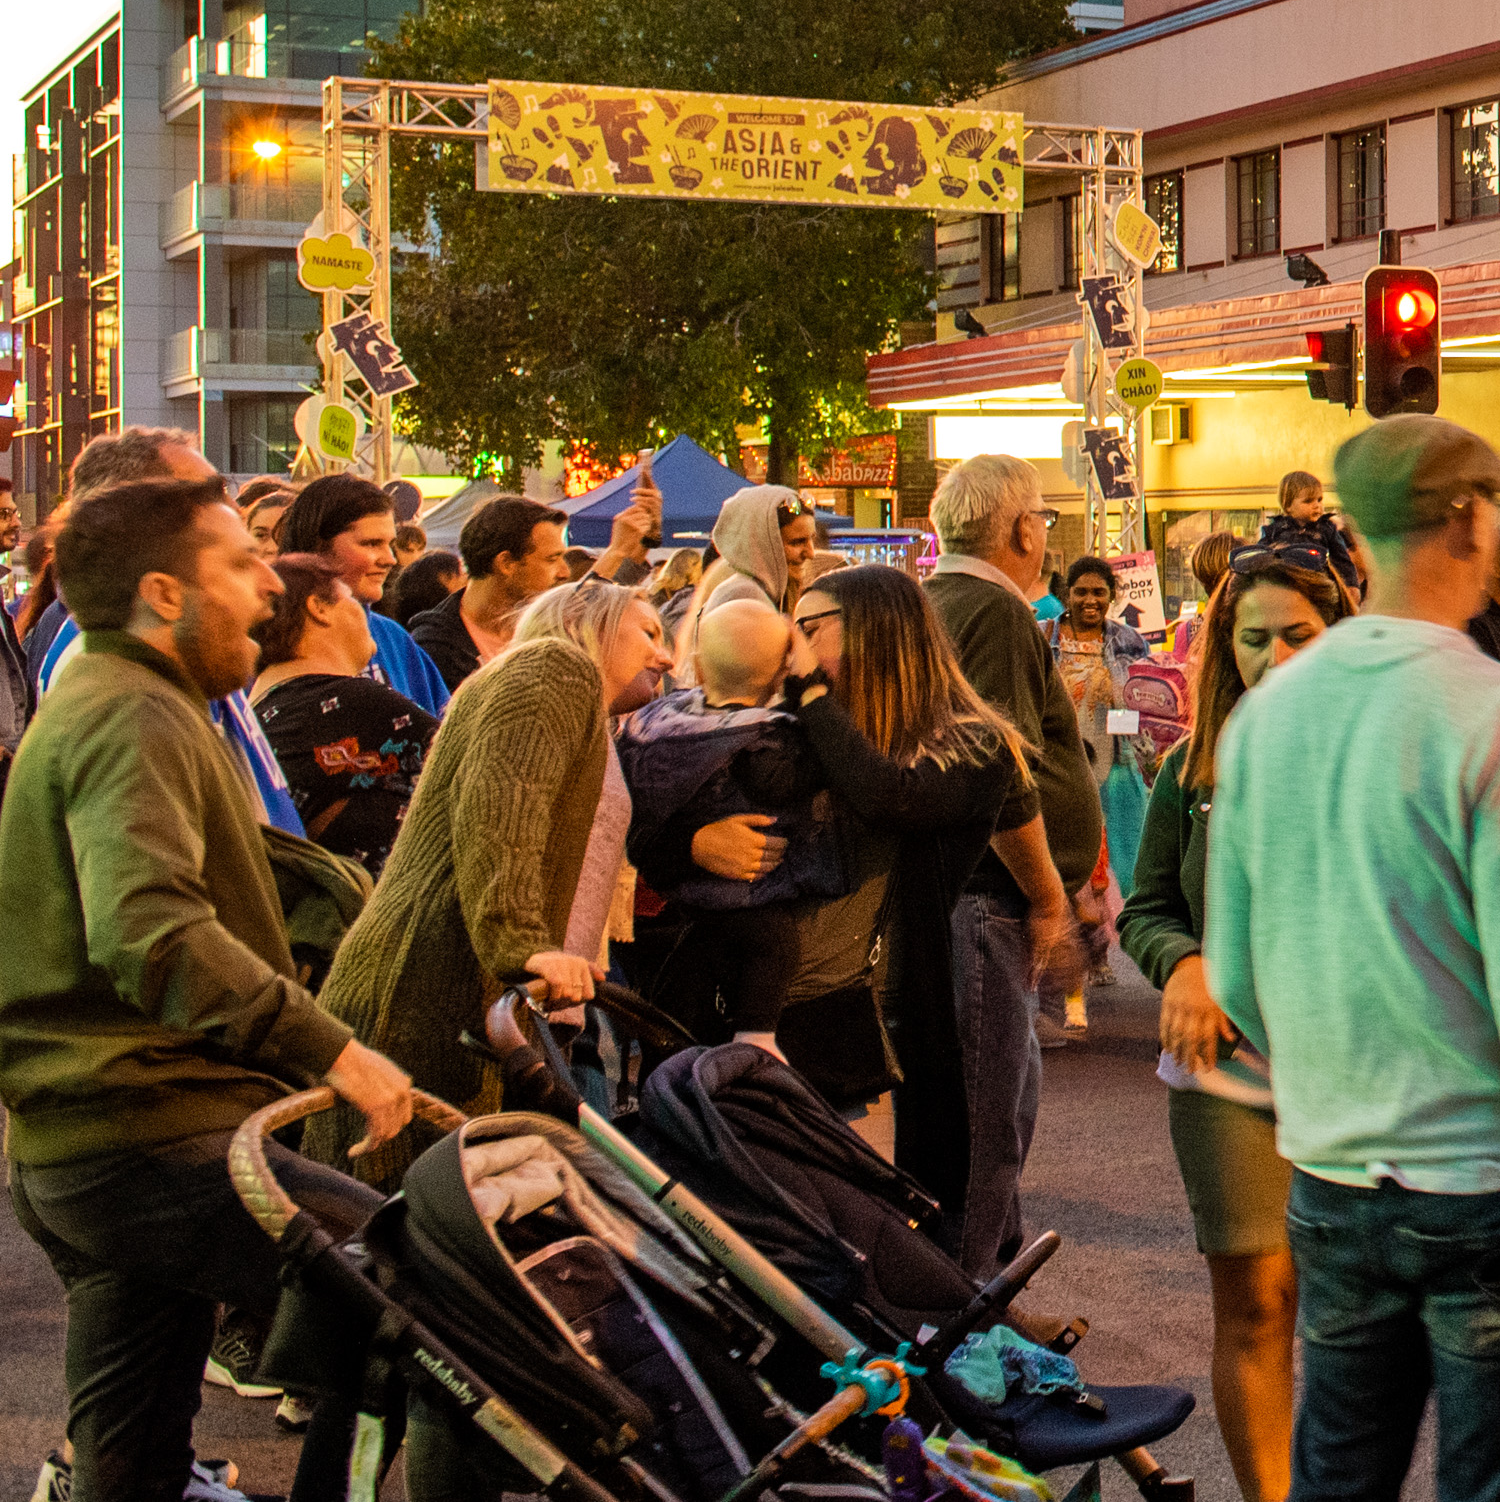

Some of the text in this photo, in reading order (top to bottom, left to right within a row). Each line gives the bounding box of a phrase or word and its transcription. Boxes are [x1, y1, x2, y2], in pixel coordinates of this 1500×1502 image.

[736, 114, 797, 124] WELCOME TO
[723, 128, 802, 155] ASIA &
[711, 157, 822, 181] THE ORIENT
[312, 255, 363, 271] NAMASTE
[1127, 368, 1146, 380] XIN
[1123, 578, 1153, 590] ebox
[1129, 588, 1154, 600] CITY
[682, 1210, 732, 1256] redsbaby
[414, 1348, 479, 1405] redsbaby
